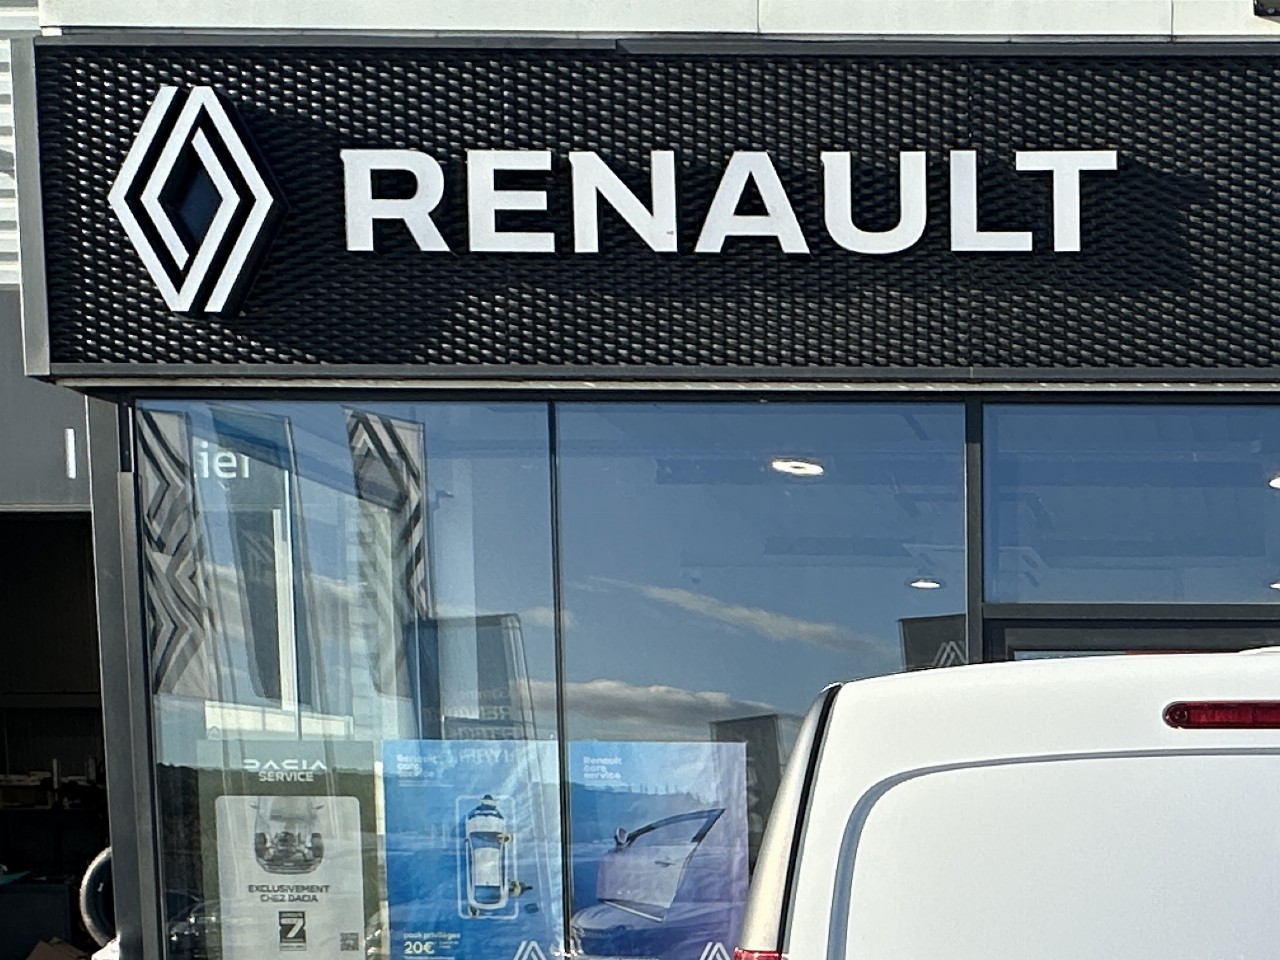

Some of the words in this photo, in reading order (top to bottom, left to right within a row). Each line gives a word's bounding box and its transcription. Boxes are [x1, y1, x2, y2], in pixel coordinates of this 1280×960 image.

[340, 148, 1118, 255] RENAULT
[242, 758, 328, 770] DACIA
[258, 771, 314, 782] SERVICE
[247, 884, 330, 894] EXCLUSIVEMENT
[260, 894, 286, 903] CHEZ
[288, 894, 319, 903] DACIA
[280, 917, 304, 938] 7
[403, 941, 435, 955] 20€
